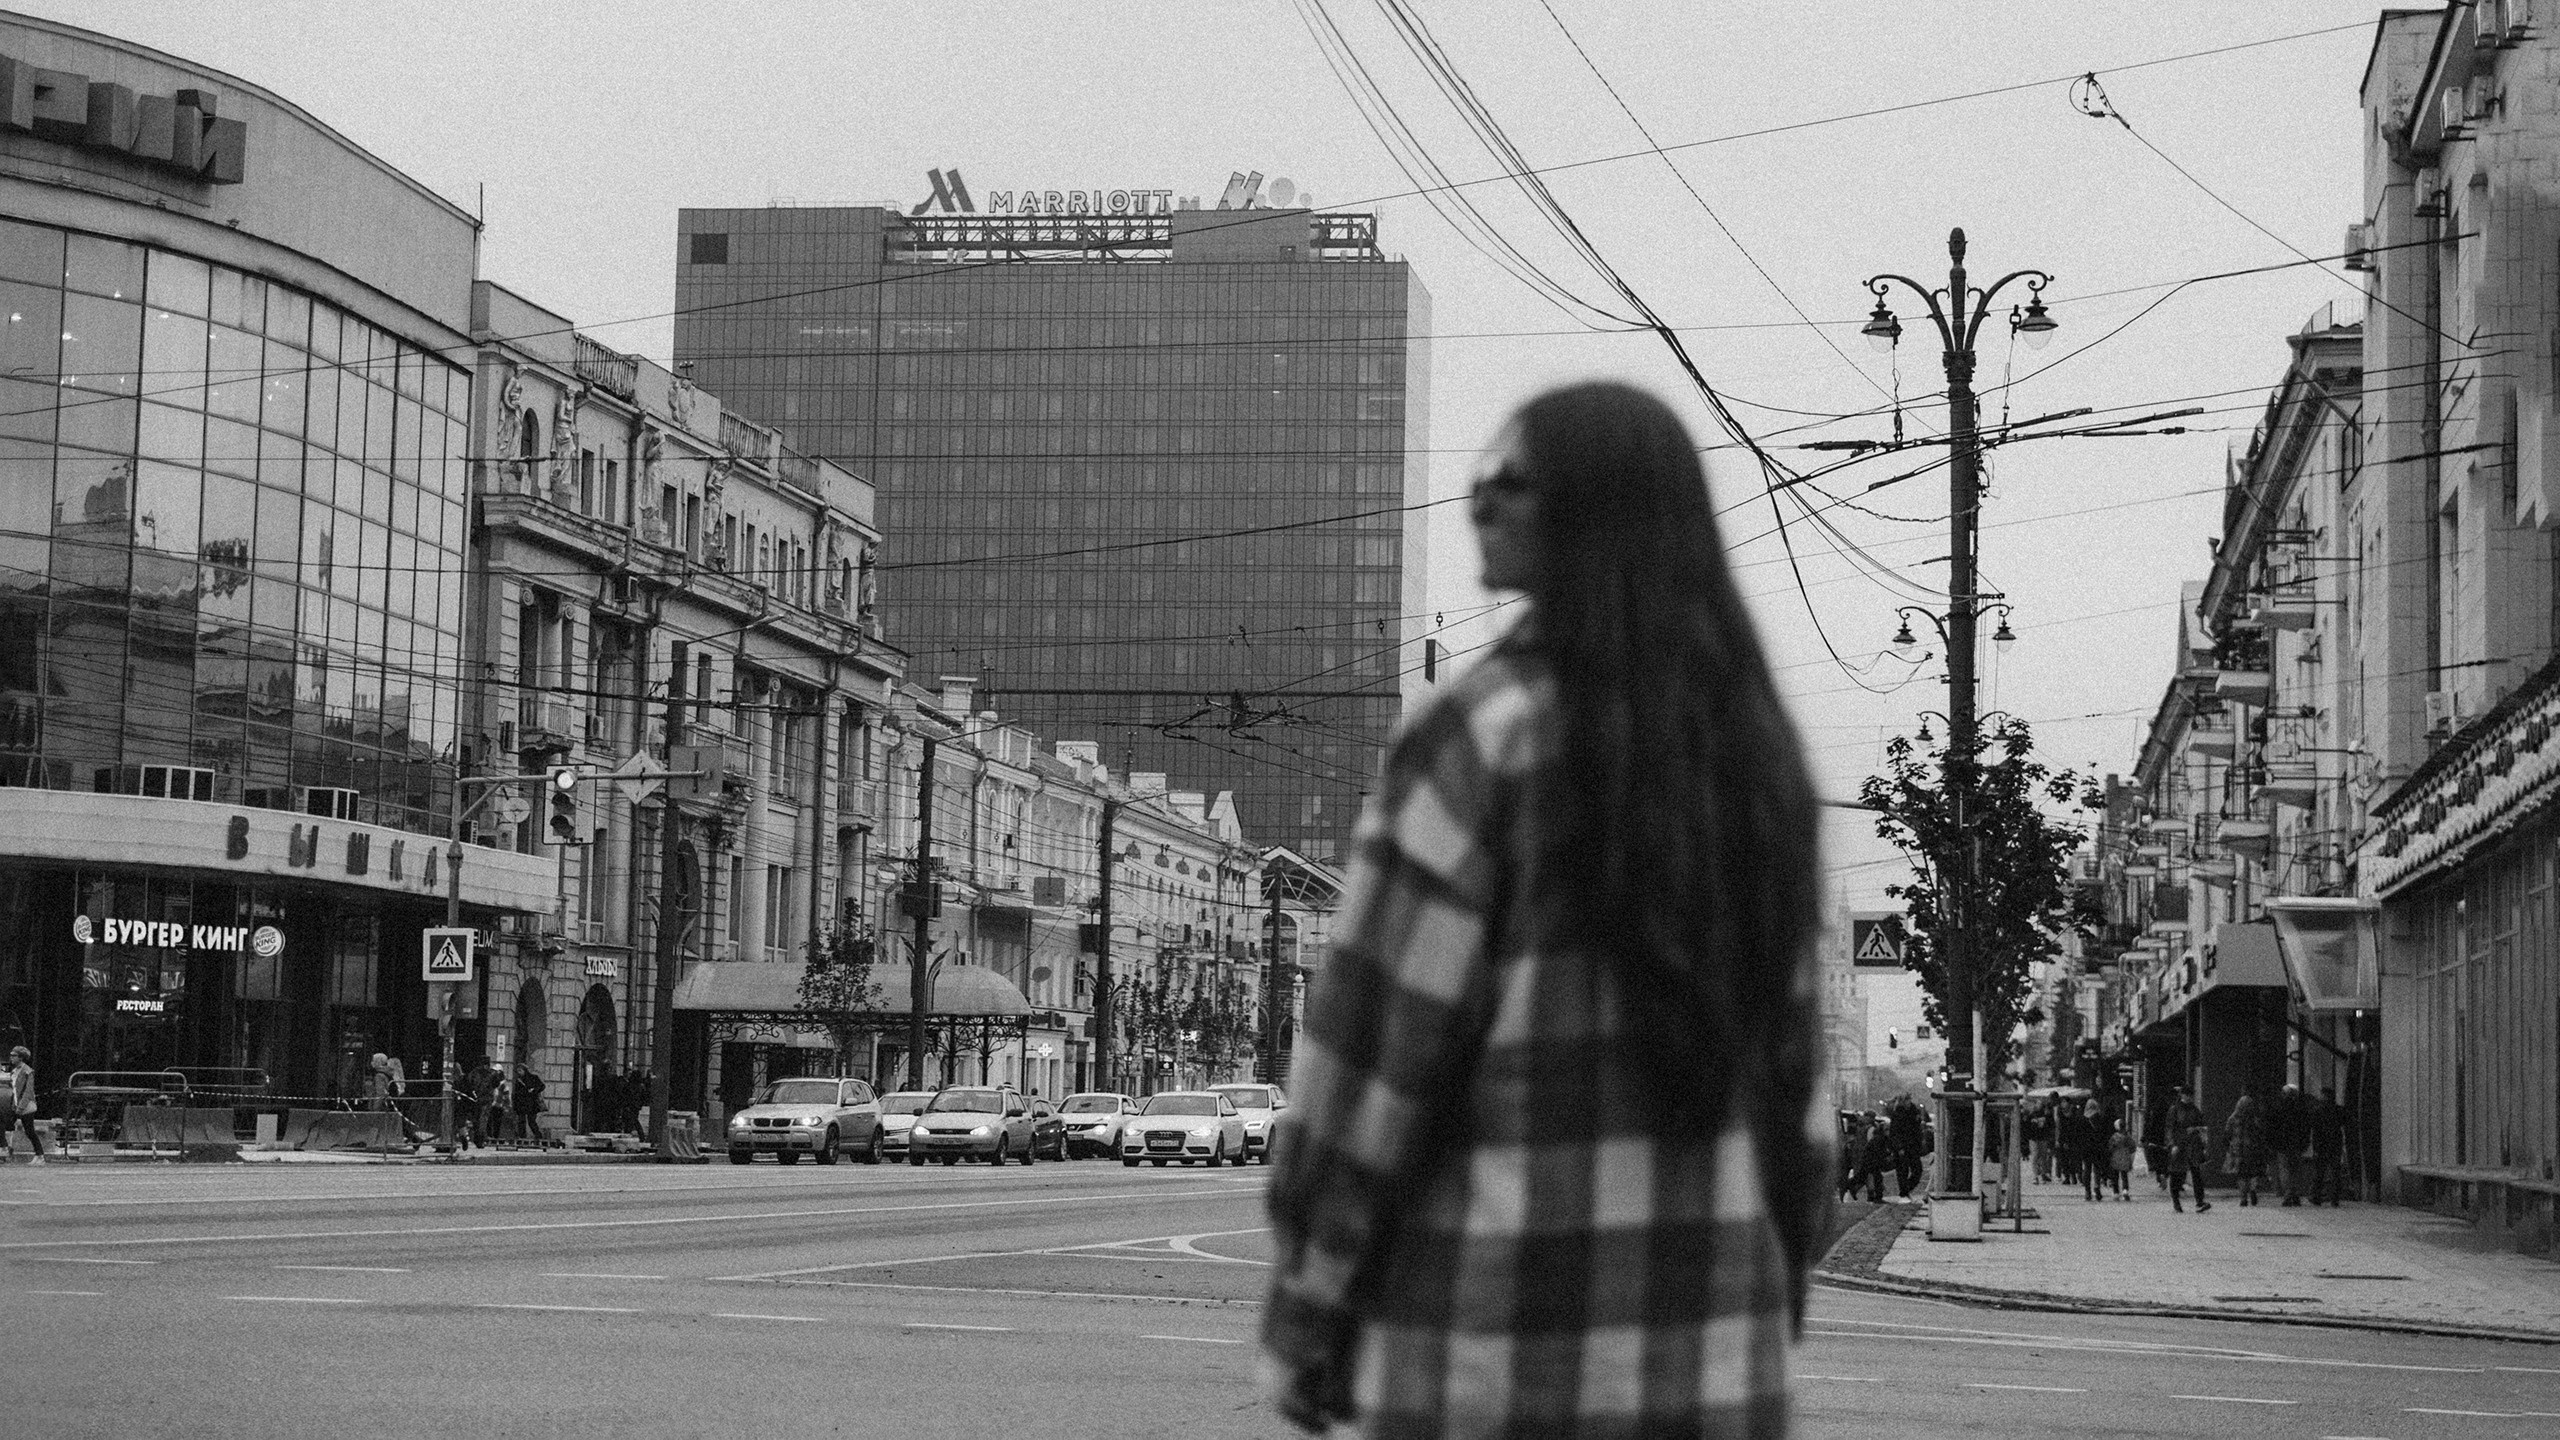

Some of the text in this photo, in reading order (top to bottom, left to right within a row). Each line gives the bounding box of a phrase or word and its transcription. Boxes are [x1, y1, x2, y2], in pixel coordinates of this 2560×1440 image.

[989, 190, 1173, 213] MARRIOTT
[104, 918, 249, 951] БУРГЕР КИНГ
[116, 1000, 164, 1012] РЕСТОРАН
